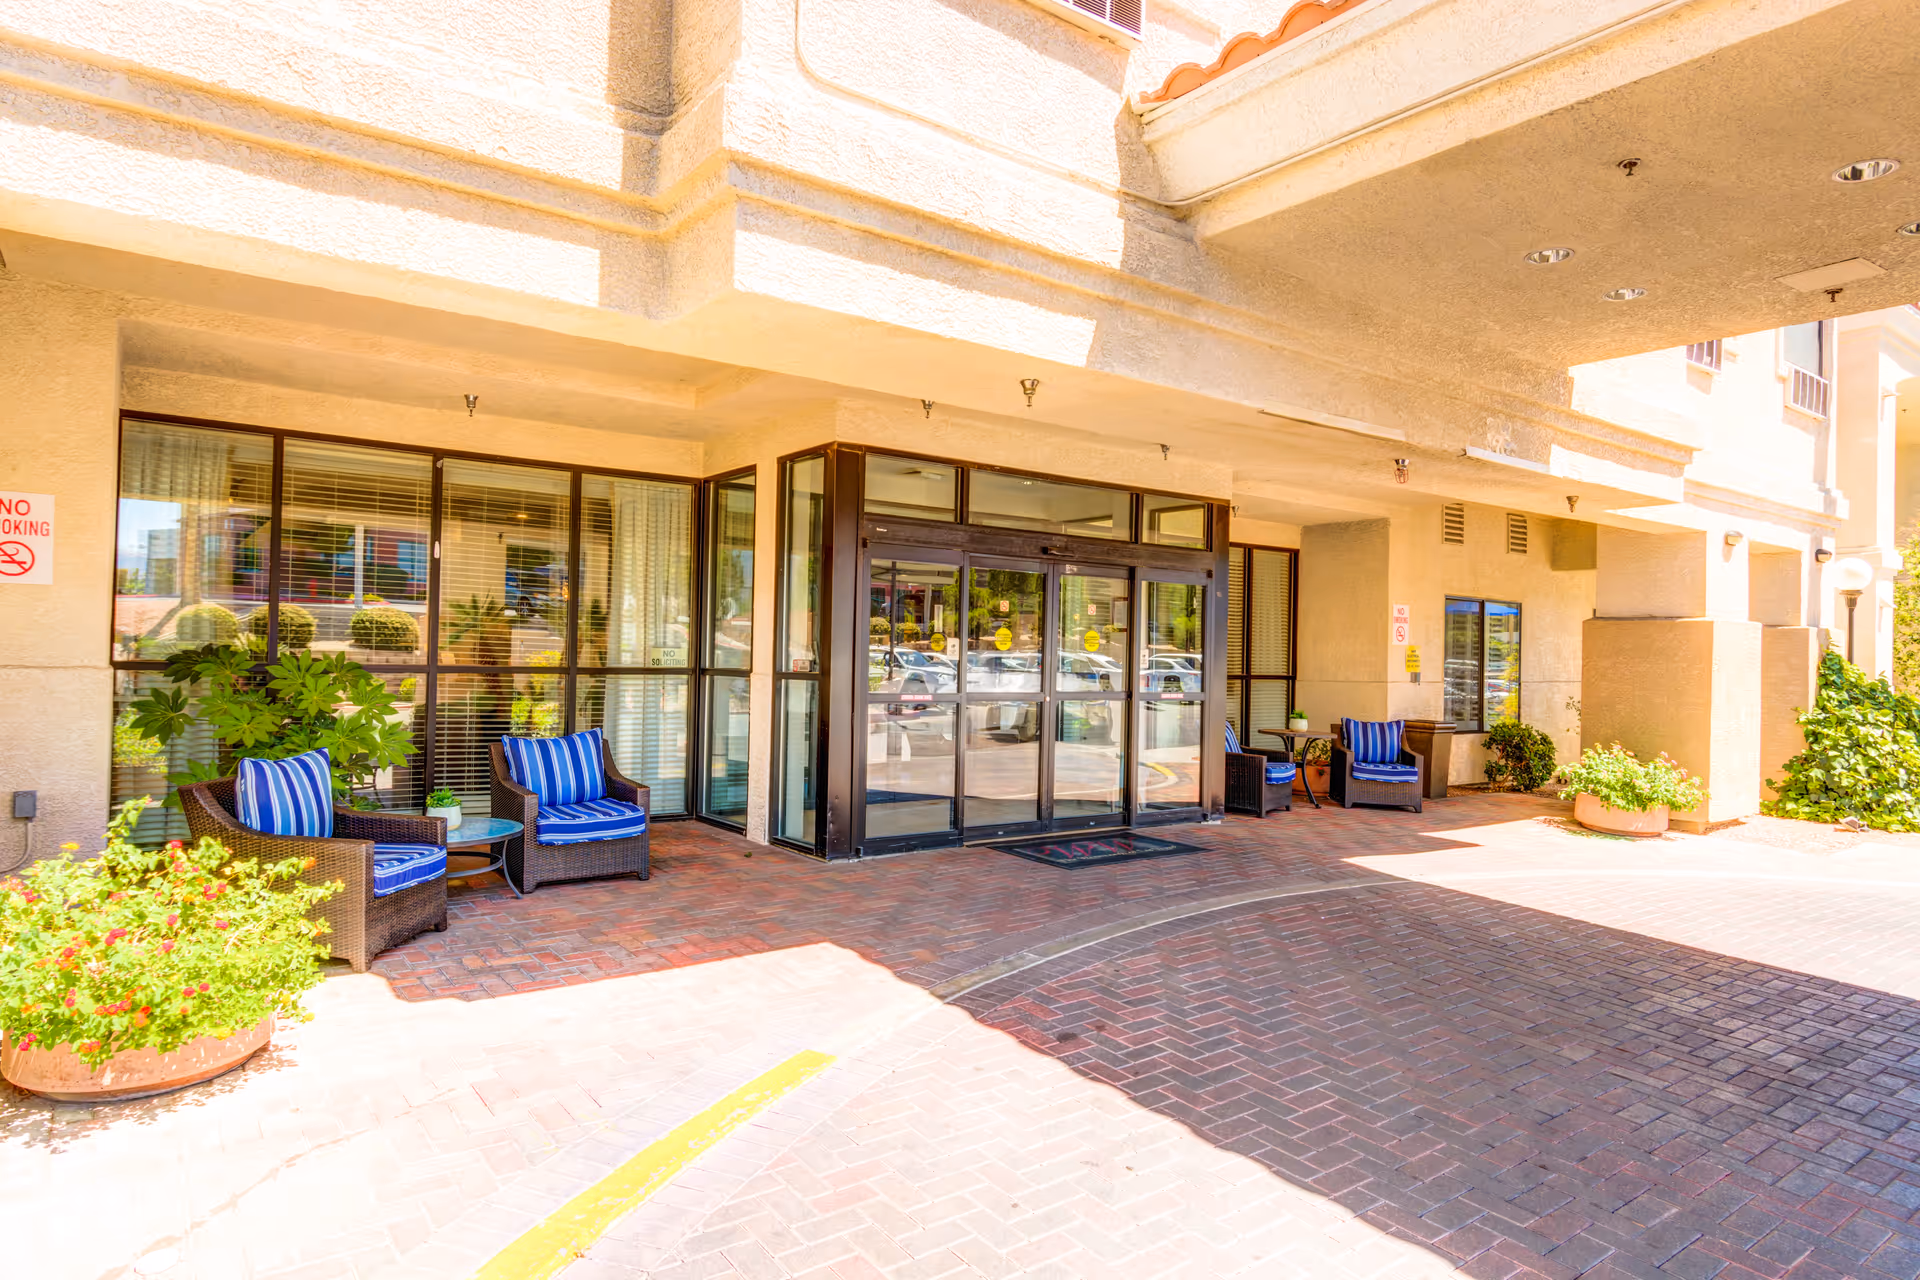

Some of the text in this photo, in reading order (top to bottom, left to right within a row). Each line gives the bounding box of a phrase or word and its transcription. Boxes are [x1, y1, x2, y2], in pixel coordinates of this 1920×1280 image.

[0, 498, 31, 516] NO
[0, 518, 50, 537] OKING
[1397, 607, 1405, 616] NO
[662, 650, 676, 658] NO
[651, 658, 686, 666] SOLICITING
